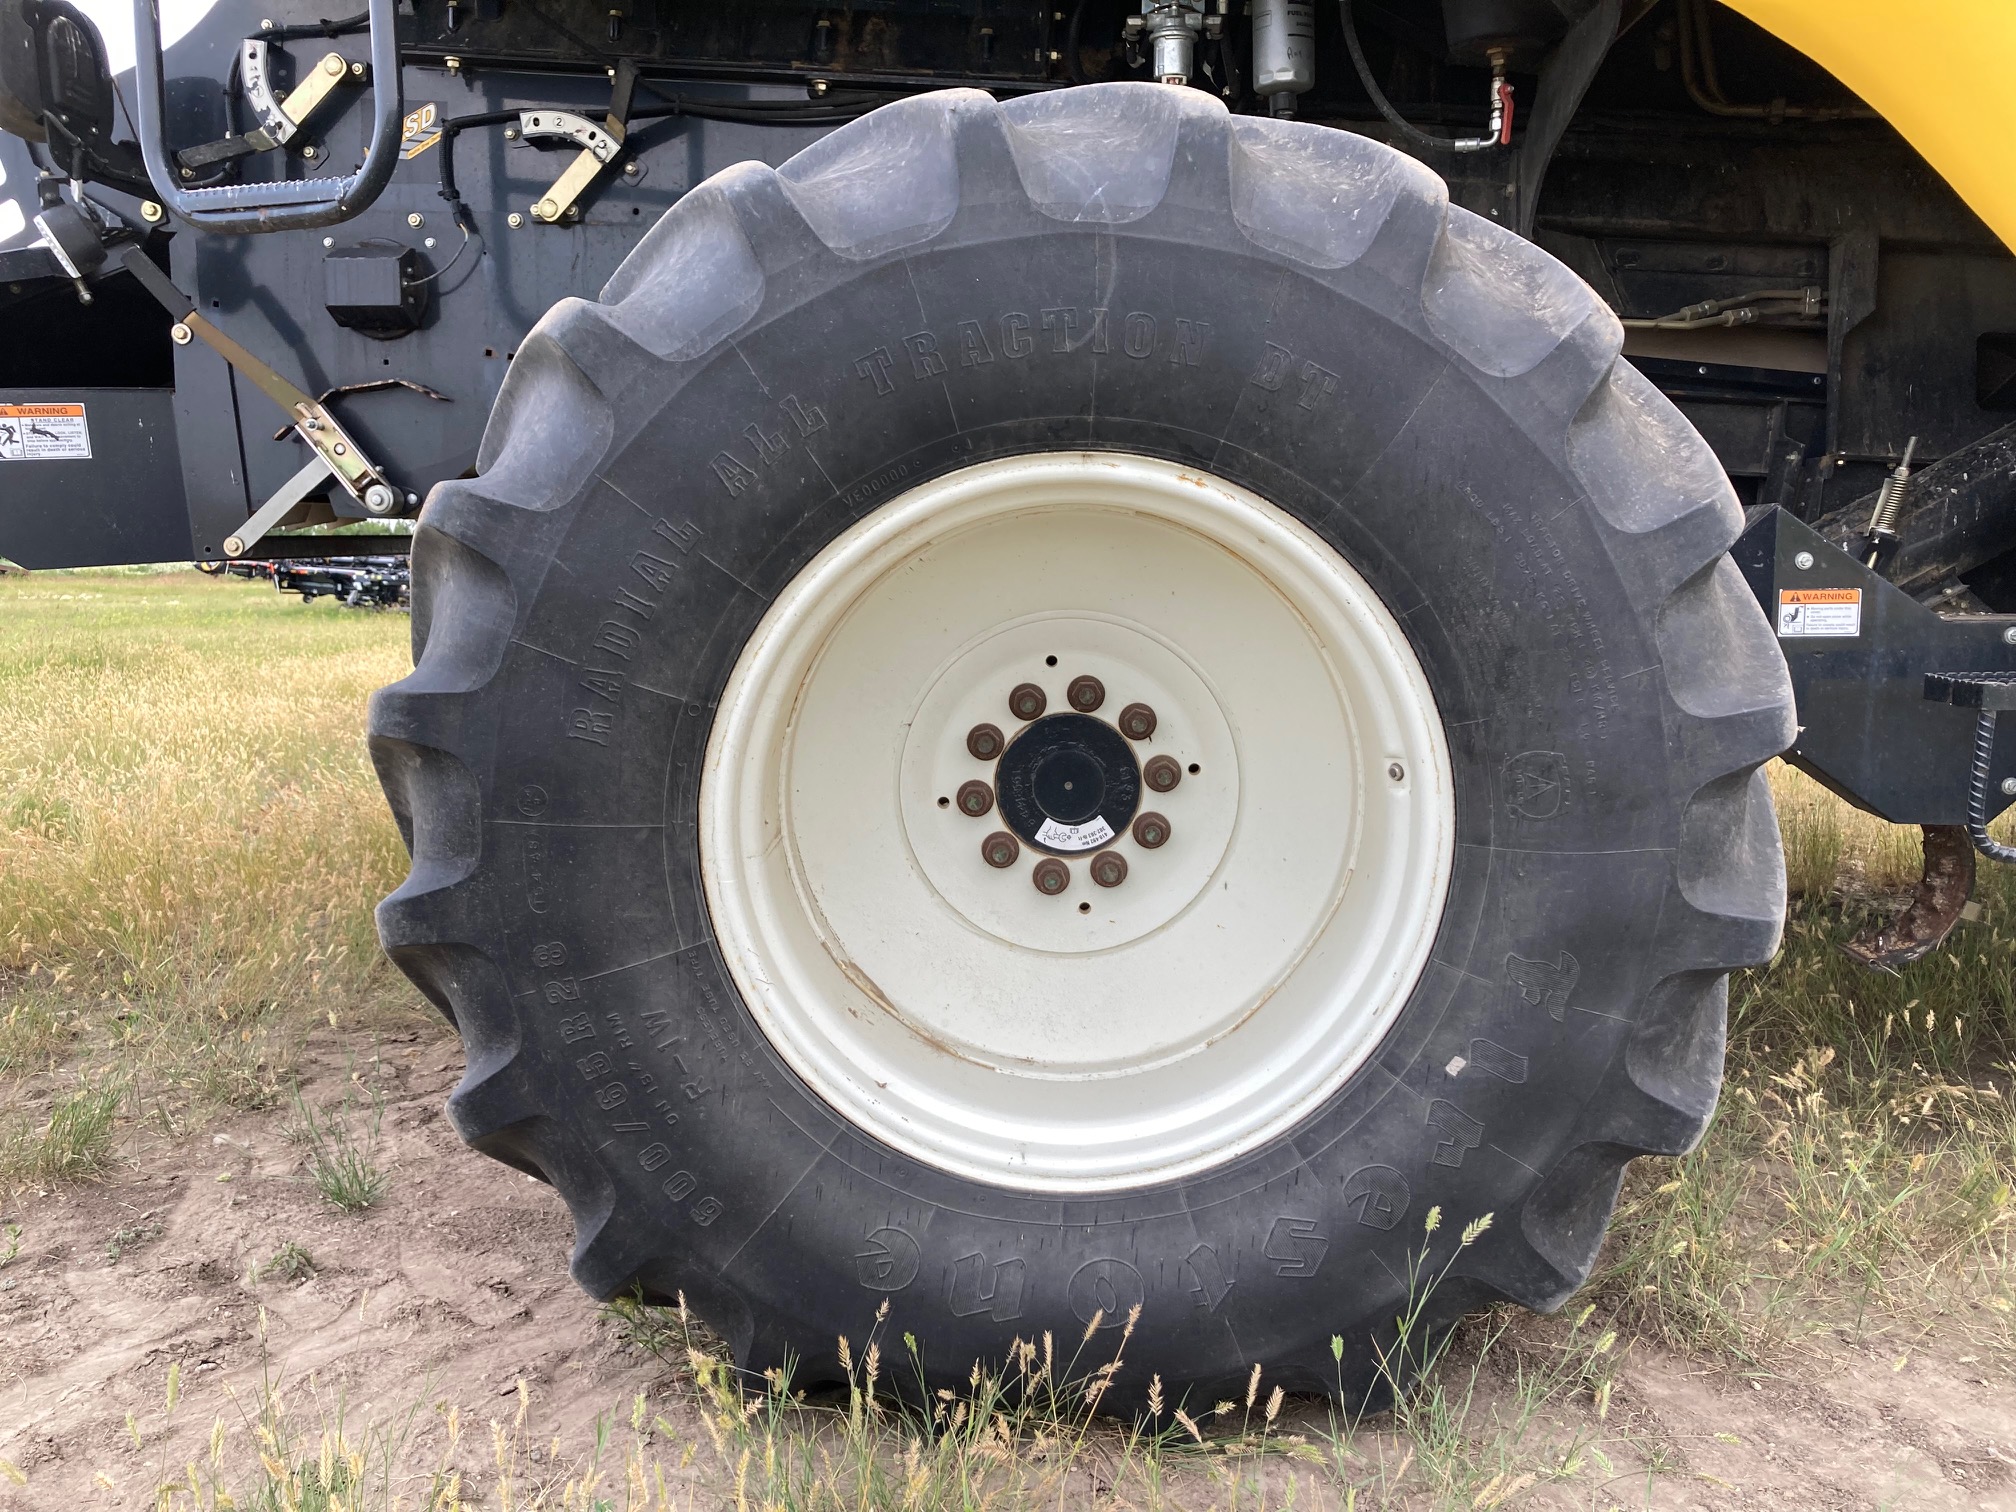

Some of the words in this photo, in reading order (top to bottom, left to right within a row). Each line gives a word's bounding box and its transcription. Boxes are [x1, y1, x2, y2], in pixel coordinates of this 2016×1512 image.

[404, 103, 437, 138] SD
[16, 407, 68, 415] WARNING
[567, 513, 705, 746] RADIAL
[708, 390, 830, 499] ALL
[854, 306, 1211, 399] TRACTION
[1250, 340, 1343, 413] DT
[1563, 571, 1585, 606] DRIVE
[1803, 592, 1853, 601] WARNING
[686, 948, 705, 979] TYPE
[702, 984, 720, 1011] TUBE
[607, 1011, 632, 1049] RIM
[695, 1006, 730, 1059] TUBELESS
[718, 1016, 740, 1046] USED
[640, 1007, 711, 1104] R-1W
[855, 950, 1580, 1328] Firestone
